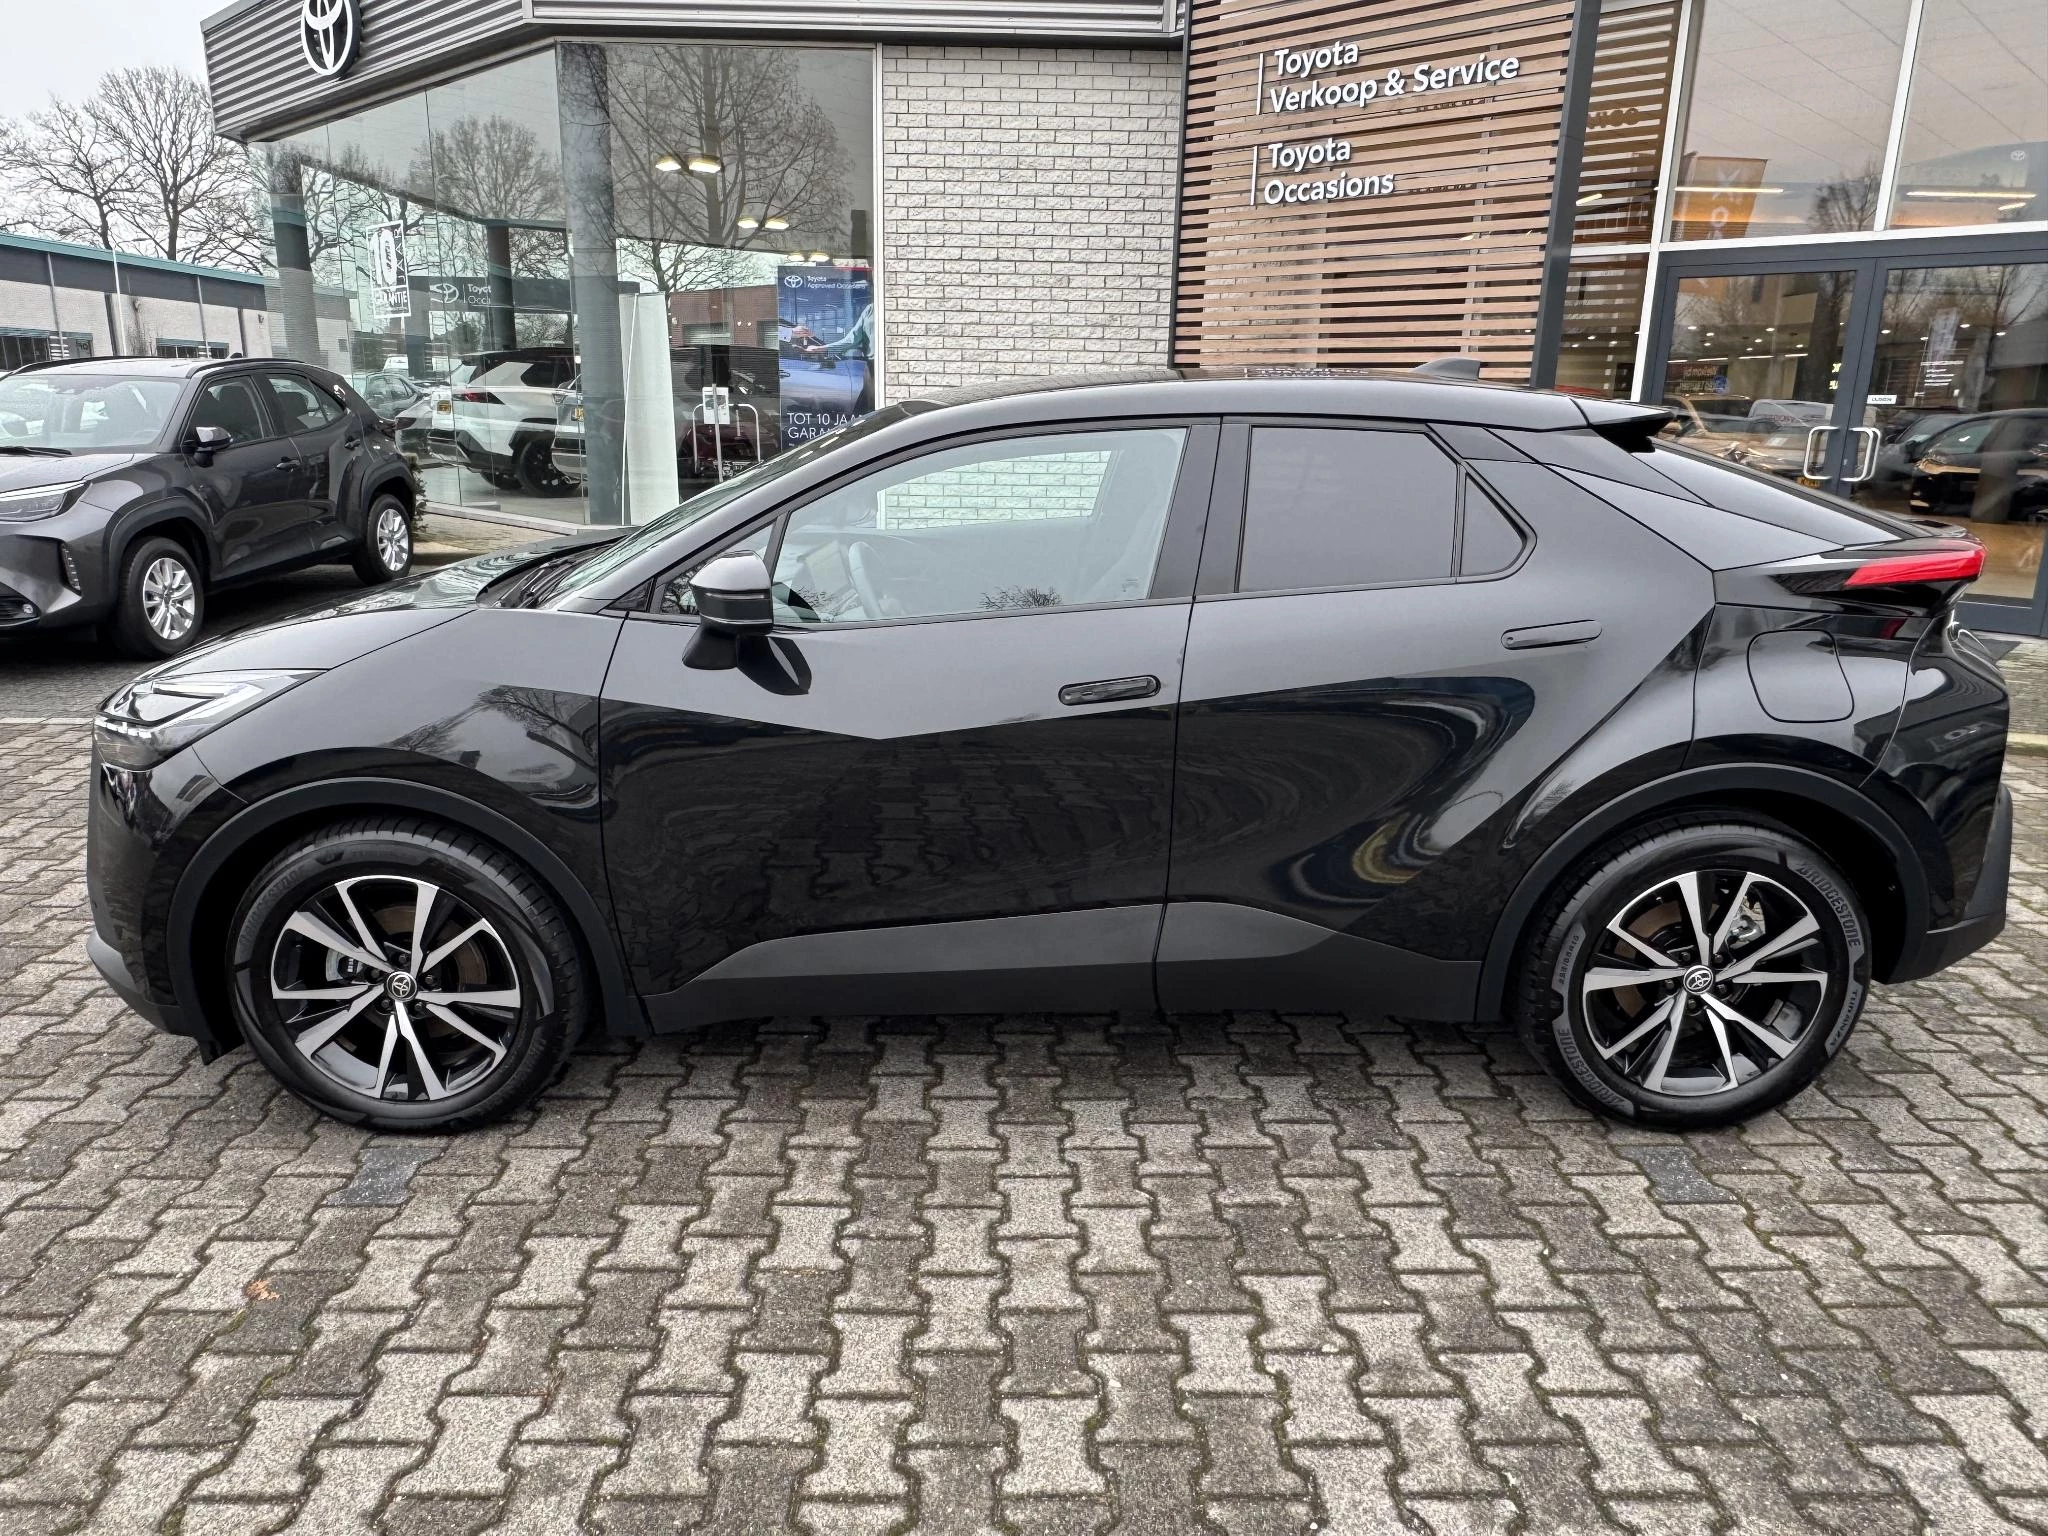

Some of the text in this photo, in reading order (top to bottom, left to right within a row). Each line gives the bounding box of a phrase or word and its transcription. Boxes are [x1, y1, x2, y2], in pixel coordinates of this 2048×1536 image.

[1274, 42, 1360, 78] Toyota
[1270, 53, 1520, 114] Verkoop & Service
[1267, 138, 1351, 172] Toyota
[1264, 172, 1395, 205] Occasions
[467, 283, 492, 295] Toyot
[786, 412, 813, 425] TOT
[816, 413, 831, 426] 10
